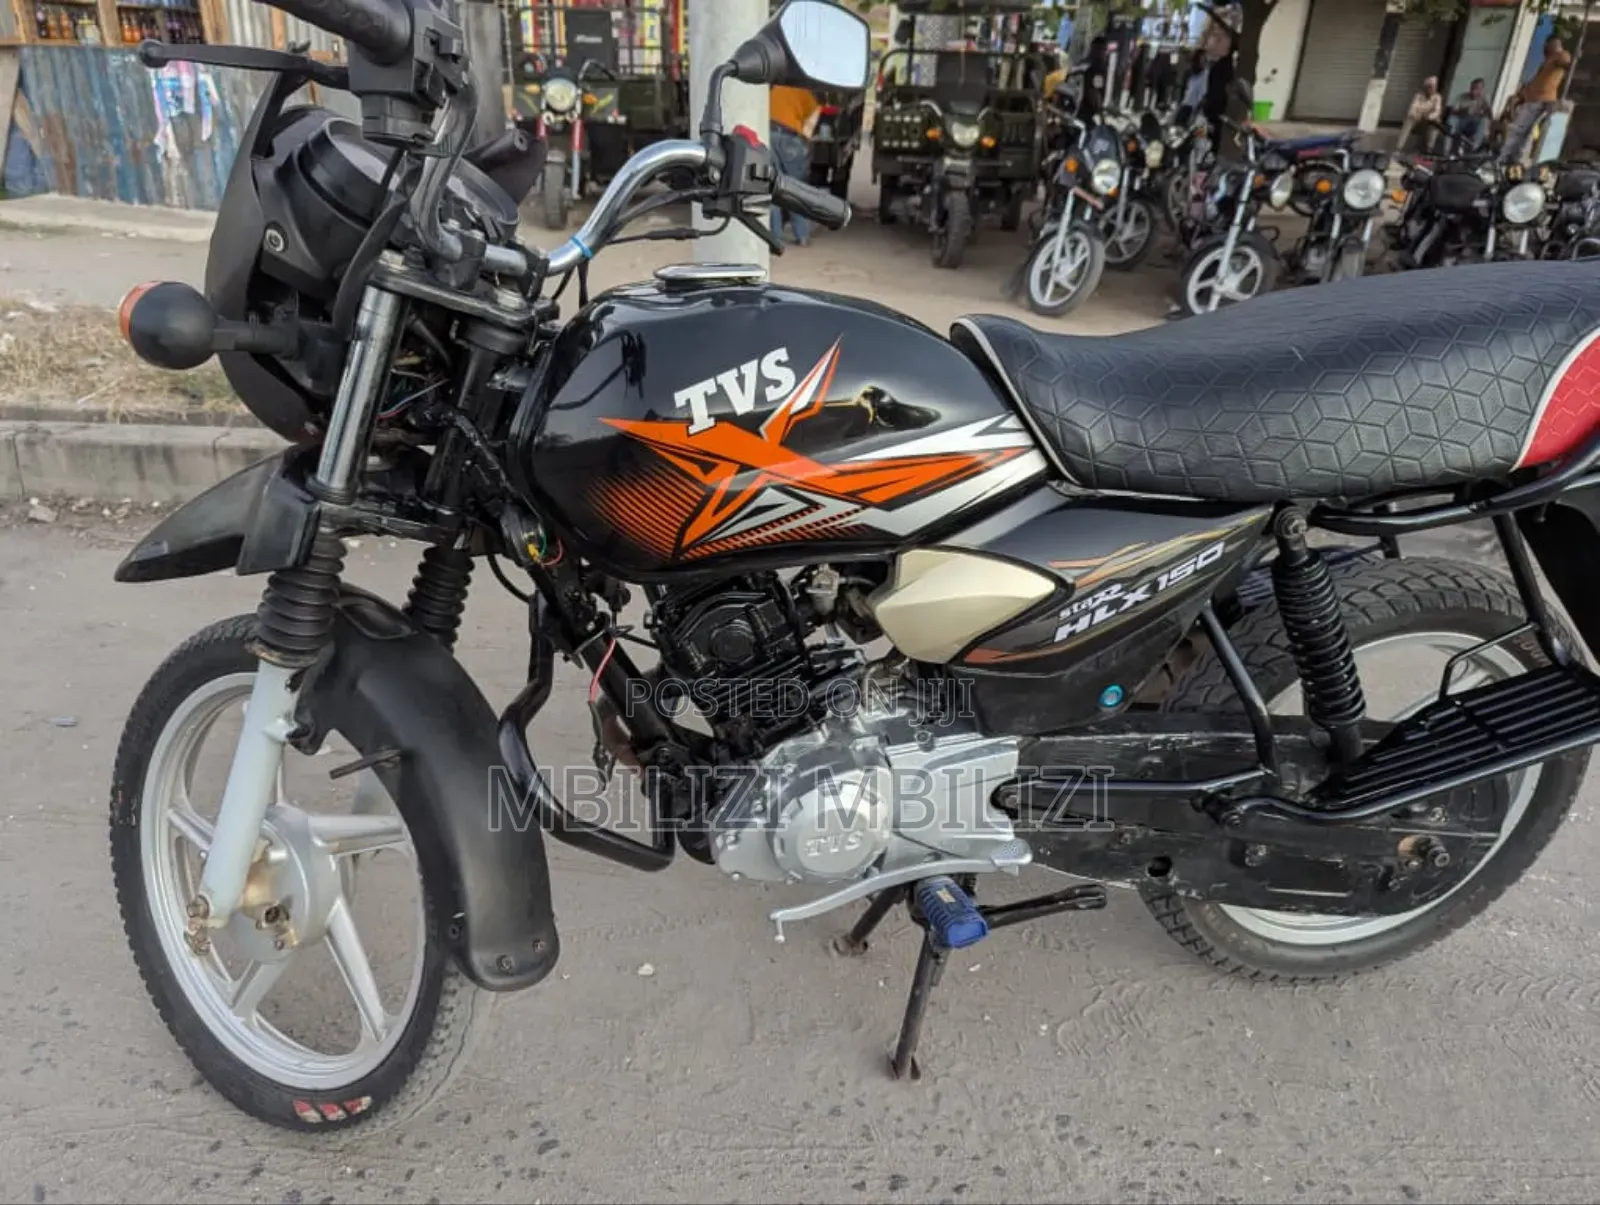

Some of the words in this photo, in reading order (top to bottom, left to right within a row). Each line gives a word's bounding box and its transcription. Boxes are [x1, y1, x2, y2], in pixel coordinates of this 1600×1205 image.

[673, 347, 796, 435] TVS
[1054, 584, 1152, 642] HLX
[1157, 541, 1225, 591] 150
